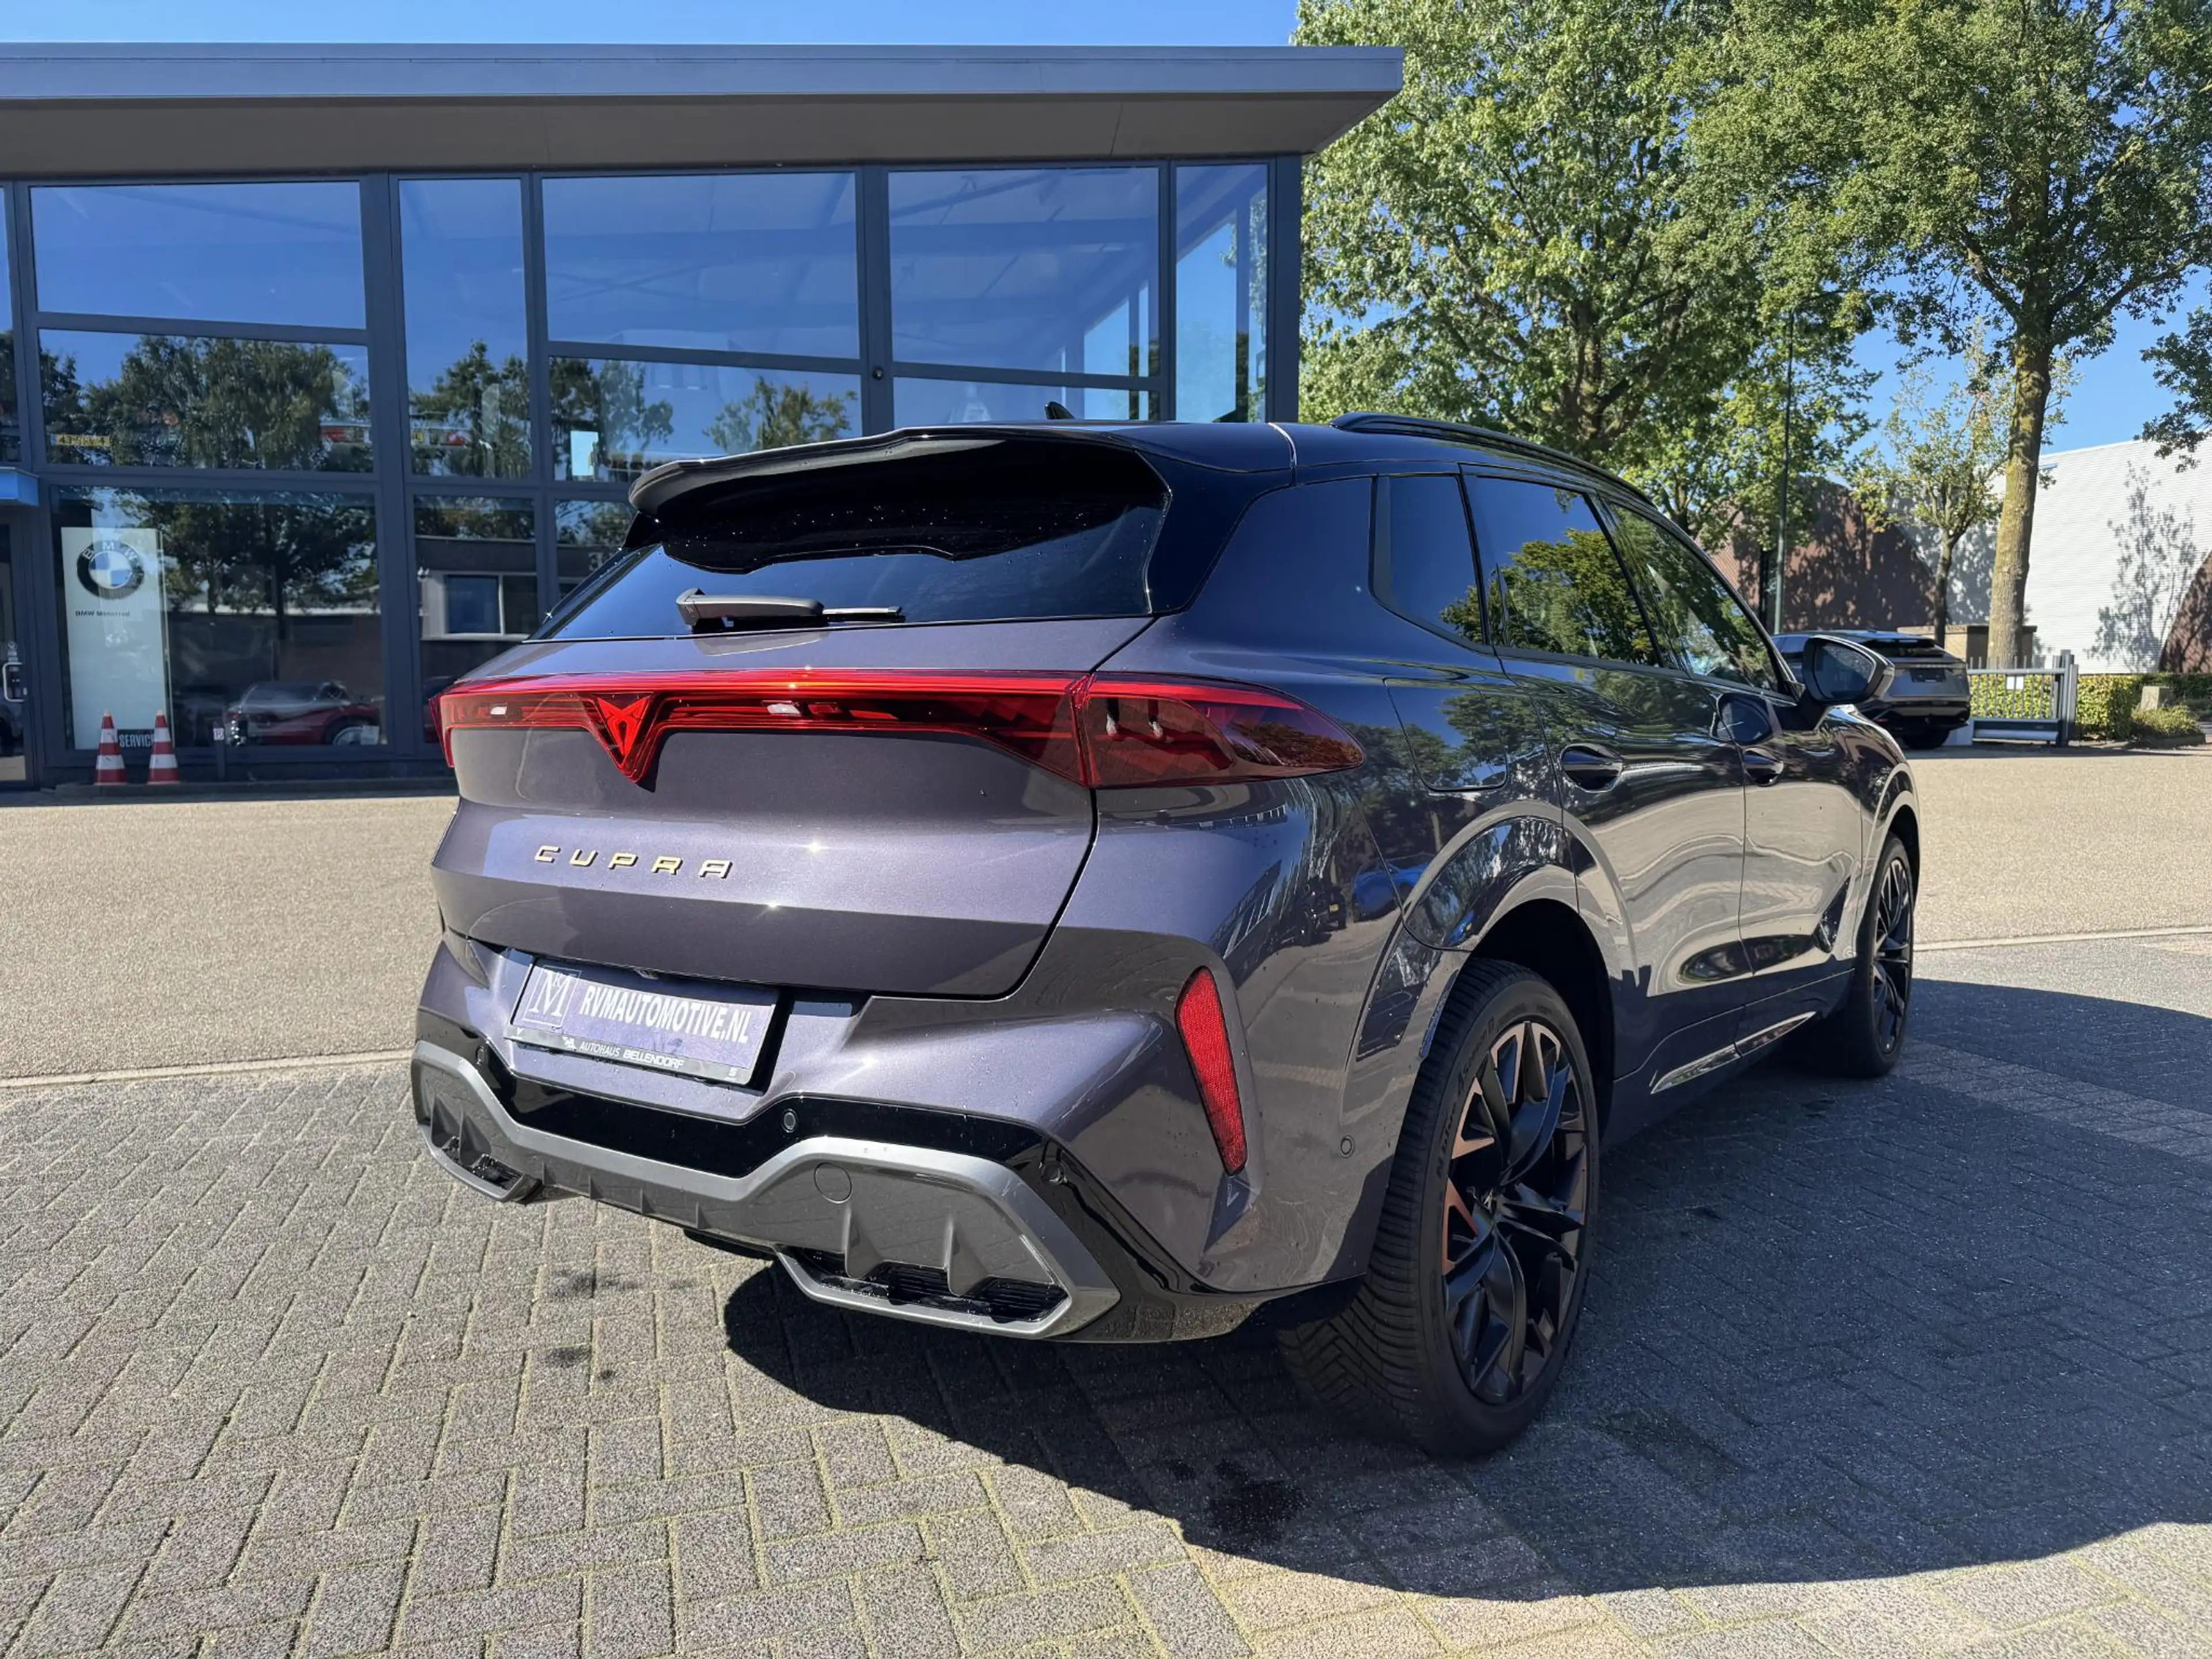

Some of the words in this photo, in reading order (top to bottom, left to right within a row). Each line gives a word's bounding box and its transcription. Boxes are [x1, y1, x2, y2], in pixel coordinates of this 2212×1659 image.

[534, 844, 733, 878] CUPRA
[579, 984, 752, 1044] RVMAUTOMOTIVE.NL
[579, 1041, 620, 1057] AUTOHAUS
[623, 1049, 685, 1069] BELLENDORF
